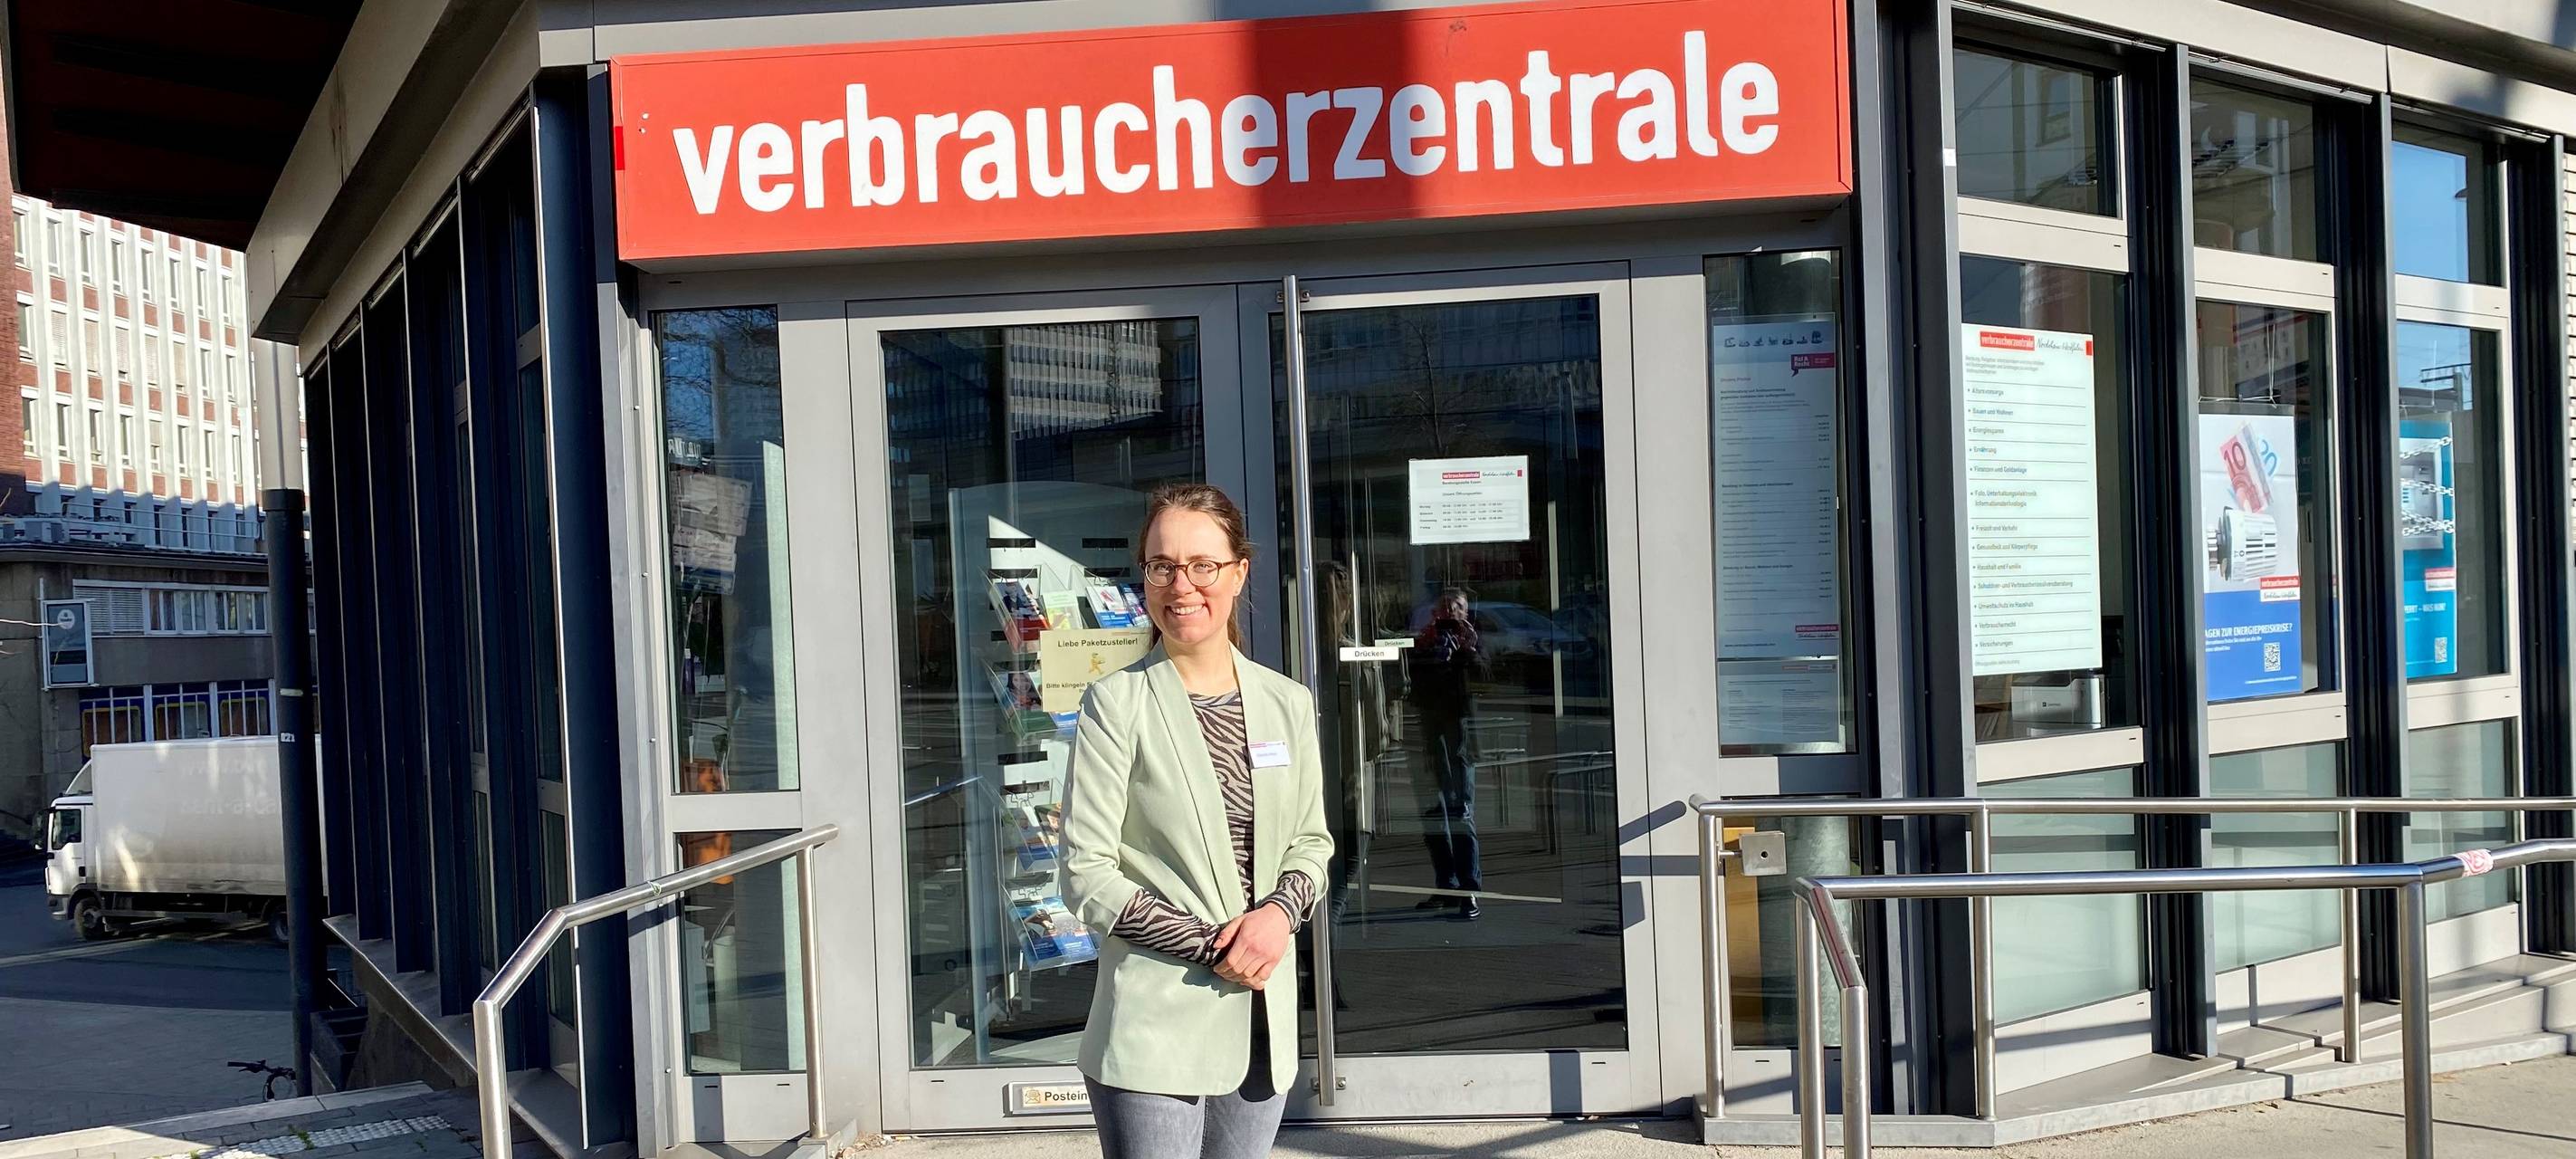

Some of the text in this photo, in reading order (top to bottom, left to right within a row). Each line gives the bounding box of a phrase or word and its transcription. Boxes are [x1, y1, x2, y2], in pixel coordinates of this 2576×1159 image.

[673, 31, 1779, 214] verbraucherzentrale
[2224, 441, 2247, 476] 10
[2221, 627, 2233, 637] ZUR
[1081, 637, 1138, 647] Paketzusteller!
[1045, 1090, 1088, 1101] Postein
